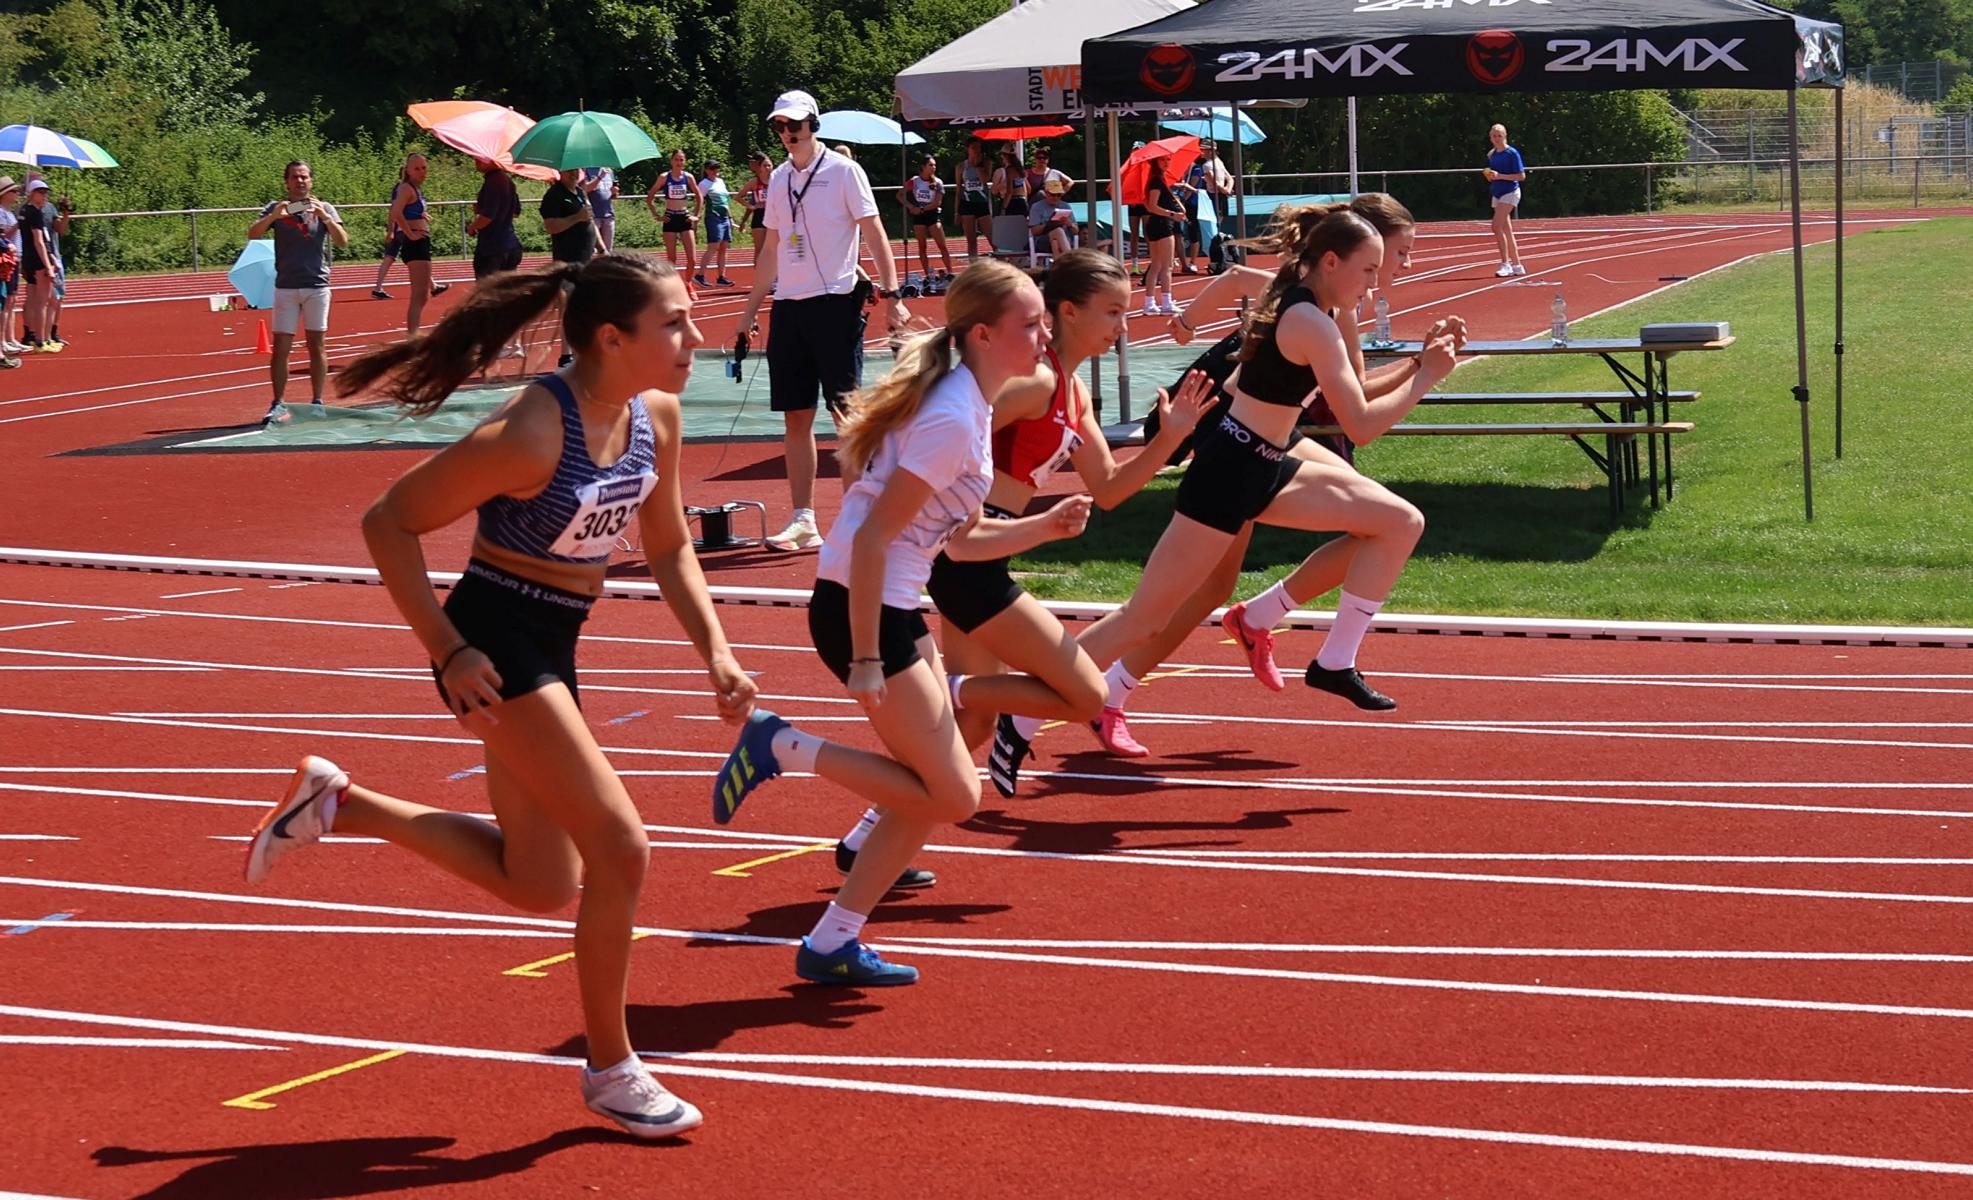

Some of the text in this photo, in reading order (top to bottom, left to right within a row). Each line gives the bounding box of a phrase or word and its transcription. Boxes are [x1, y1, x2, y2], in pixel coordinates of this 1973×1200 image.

[1215, 43, 1414, 82] 24MX
[1545, 38, 1749, 72] 24MX
[1028, 67, 1043, 111] STADT
